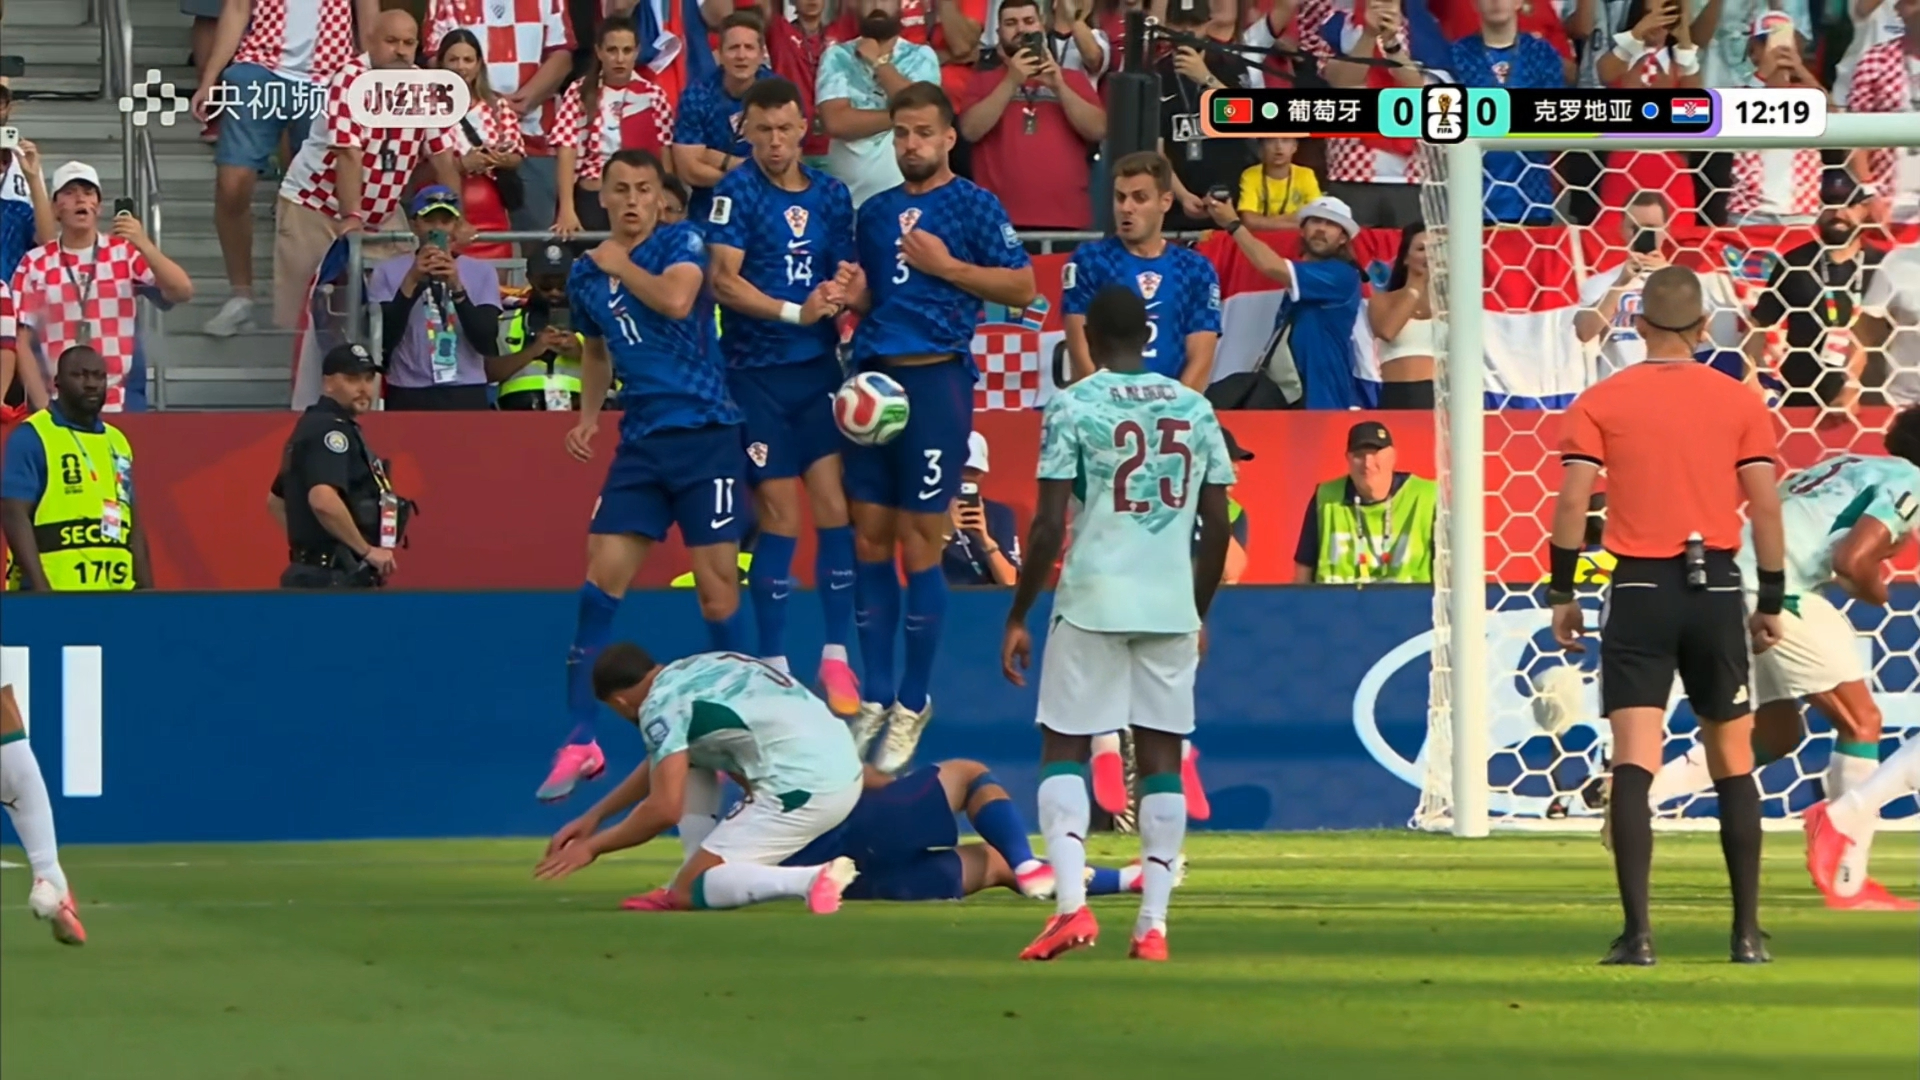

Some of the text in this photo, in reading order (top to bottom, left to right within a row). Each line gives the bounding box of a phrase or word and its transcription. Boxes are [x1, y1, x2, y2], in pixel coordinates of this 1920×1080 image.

[784, 254, 813, 287] 14
[892, 251, 910, 285] 3
[615, 314, 642, 345] 11
[923, 449, 942, 486] 3
[1113, 417, 1193, 514] 25
[713, 478, 735, 514] 11
